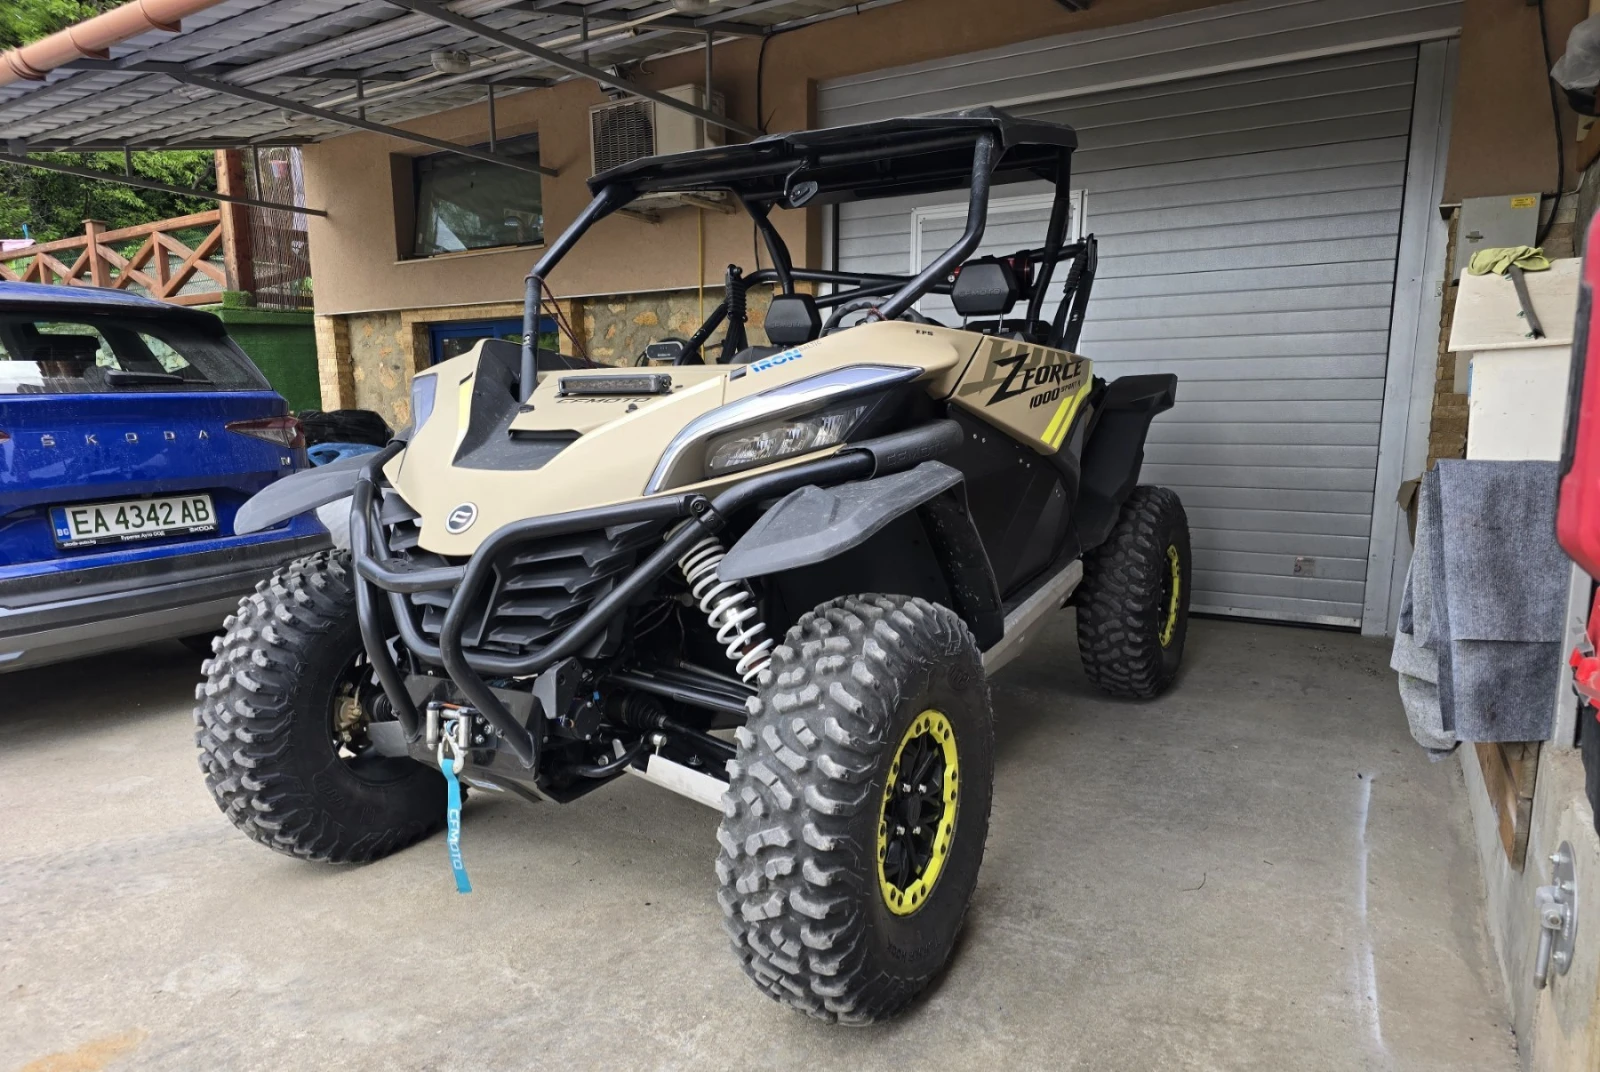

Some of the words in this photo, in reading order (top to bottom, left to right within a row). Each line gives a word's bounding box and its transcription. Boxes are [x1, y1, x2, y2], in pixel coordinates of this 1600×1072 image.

[751, 348, 803, 373] IRON
[1029, 387, 1060, 409] 1000
[41, 429, 209, 447] ŠKODA
[71, 509, 110, 536] EA
[115, 503, 176, 530] 4342
[181, 499, 210, 524] AB
[57, 528, 70, 537] BG
[449, 808, 463, 870] CFMOTO
